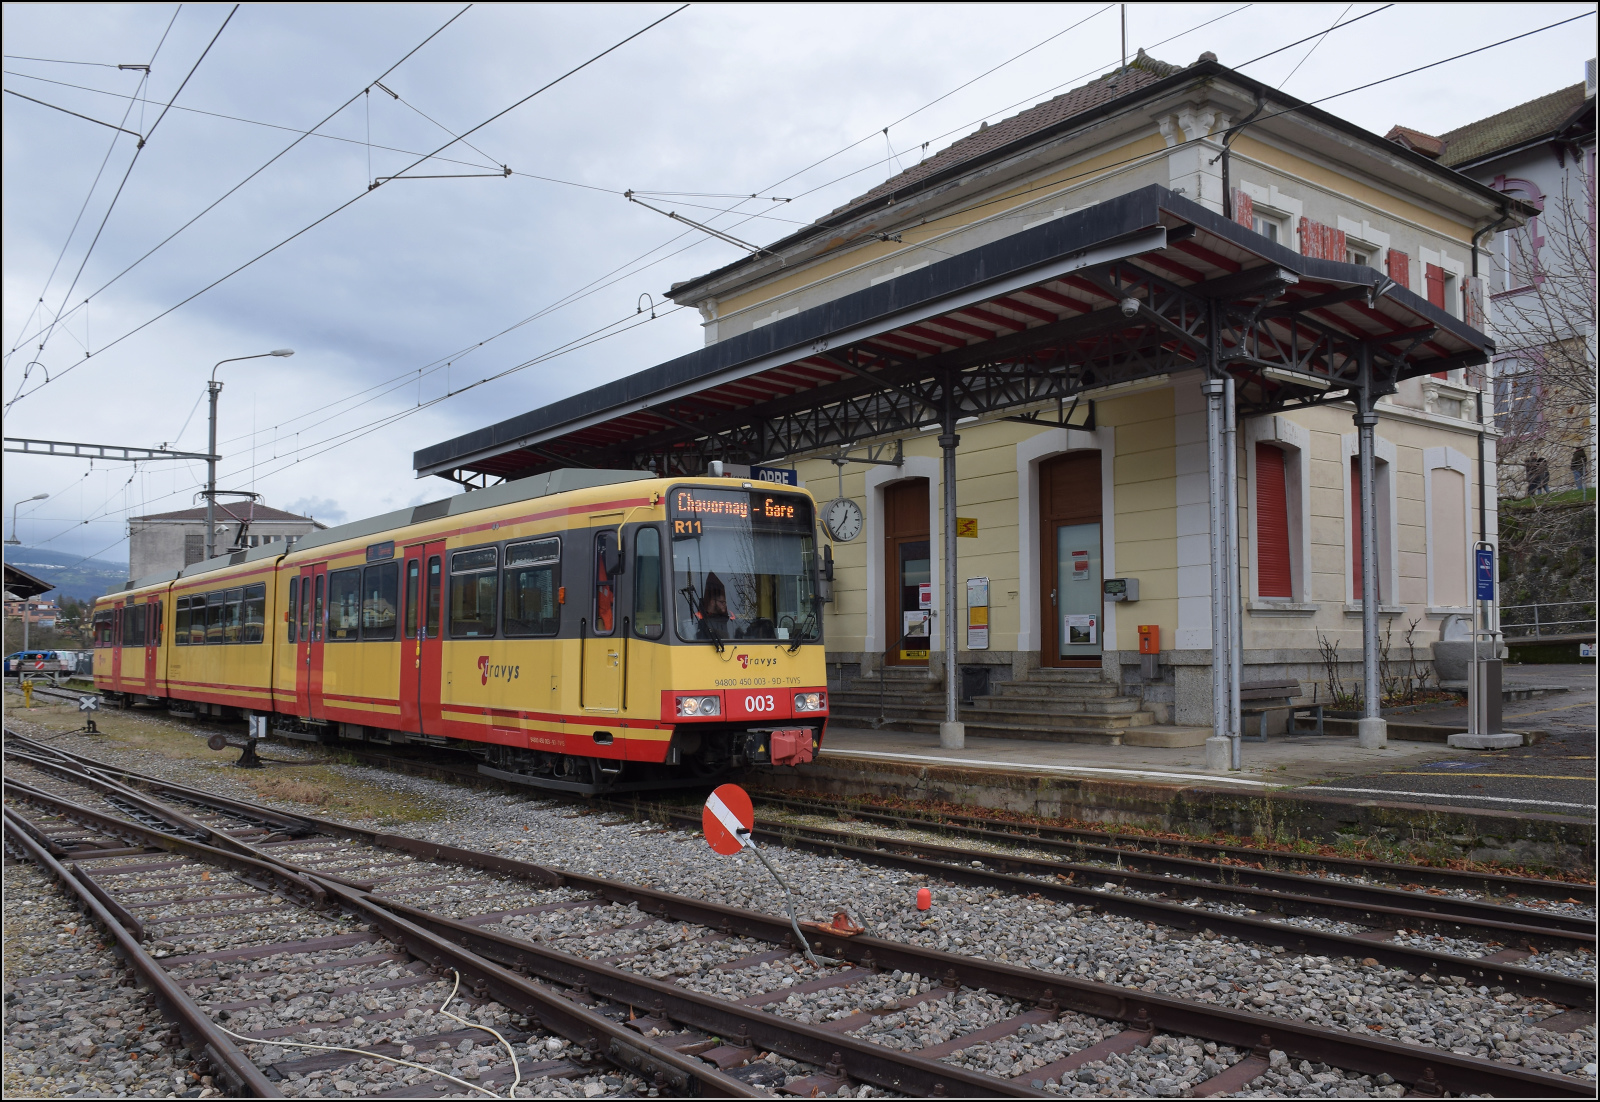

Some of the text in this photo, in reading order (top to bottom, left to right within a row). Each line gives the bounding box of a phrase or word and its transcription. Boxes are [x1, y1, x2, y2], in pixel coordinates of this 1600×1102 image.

[678, 492, 748, 518] Chavornay
[765, 498, 794, 518] Gare
[674, 520, 702, 534] R11
[742, 655, 777, 667] travys
[481, 658, 520, 683] travys
[715, 678, 737, 687] 94800
[739, 677, 752, 686] 450
[753, 677, 766, 686] 003
[744, 694, 775, 712] 003
